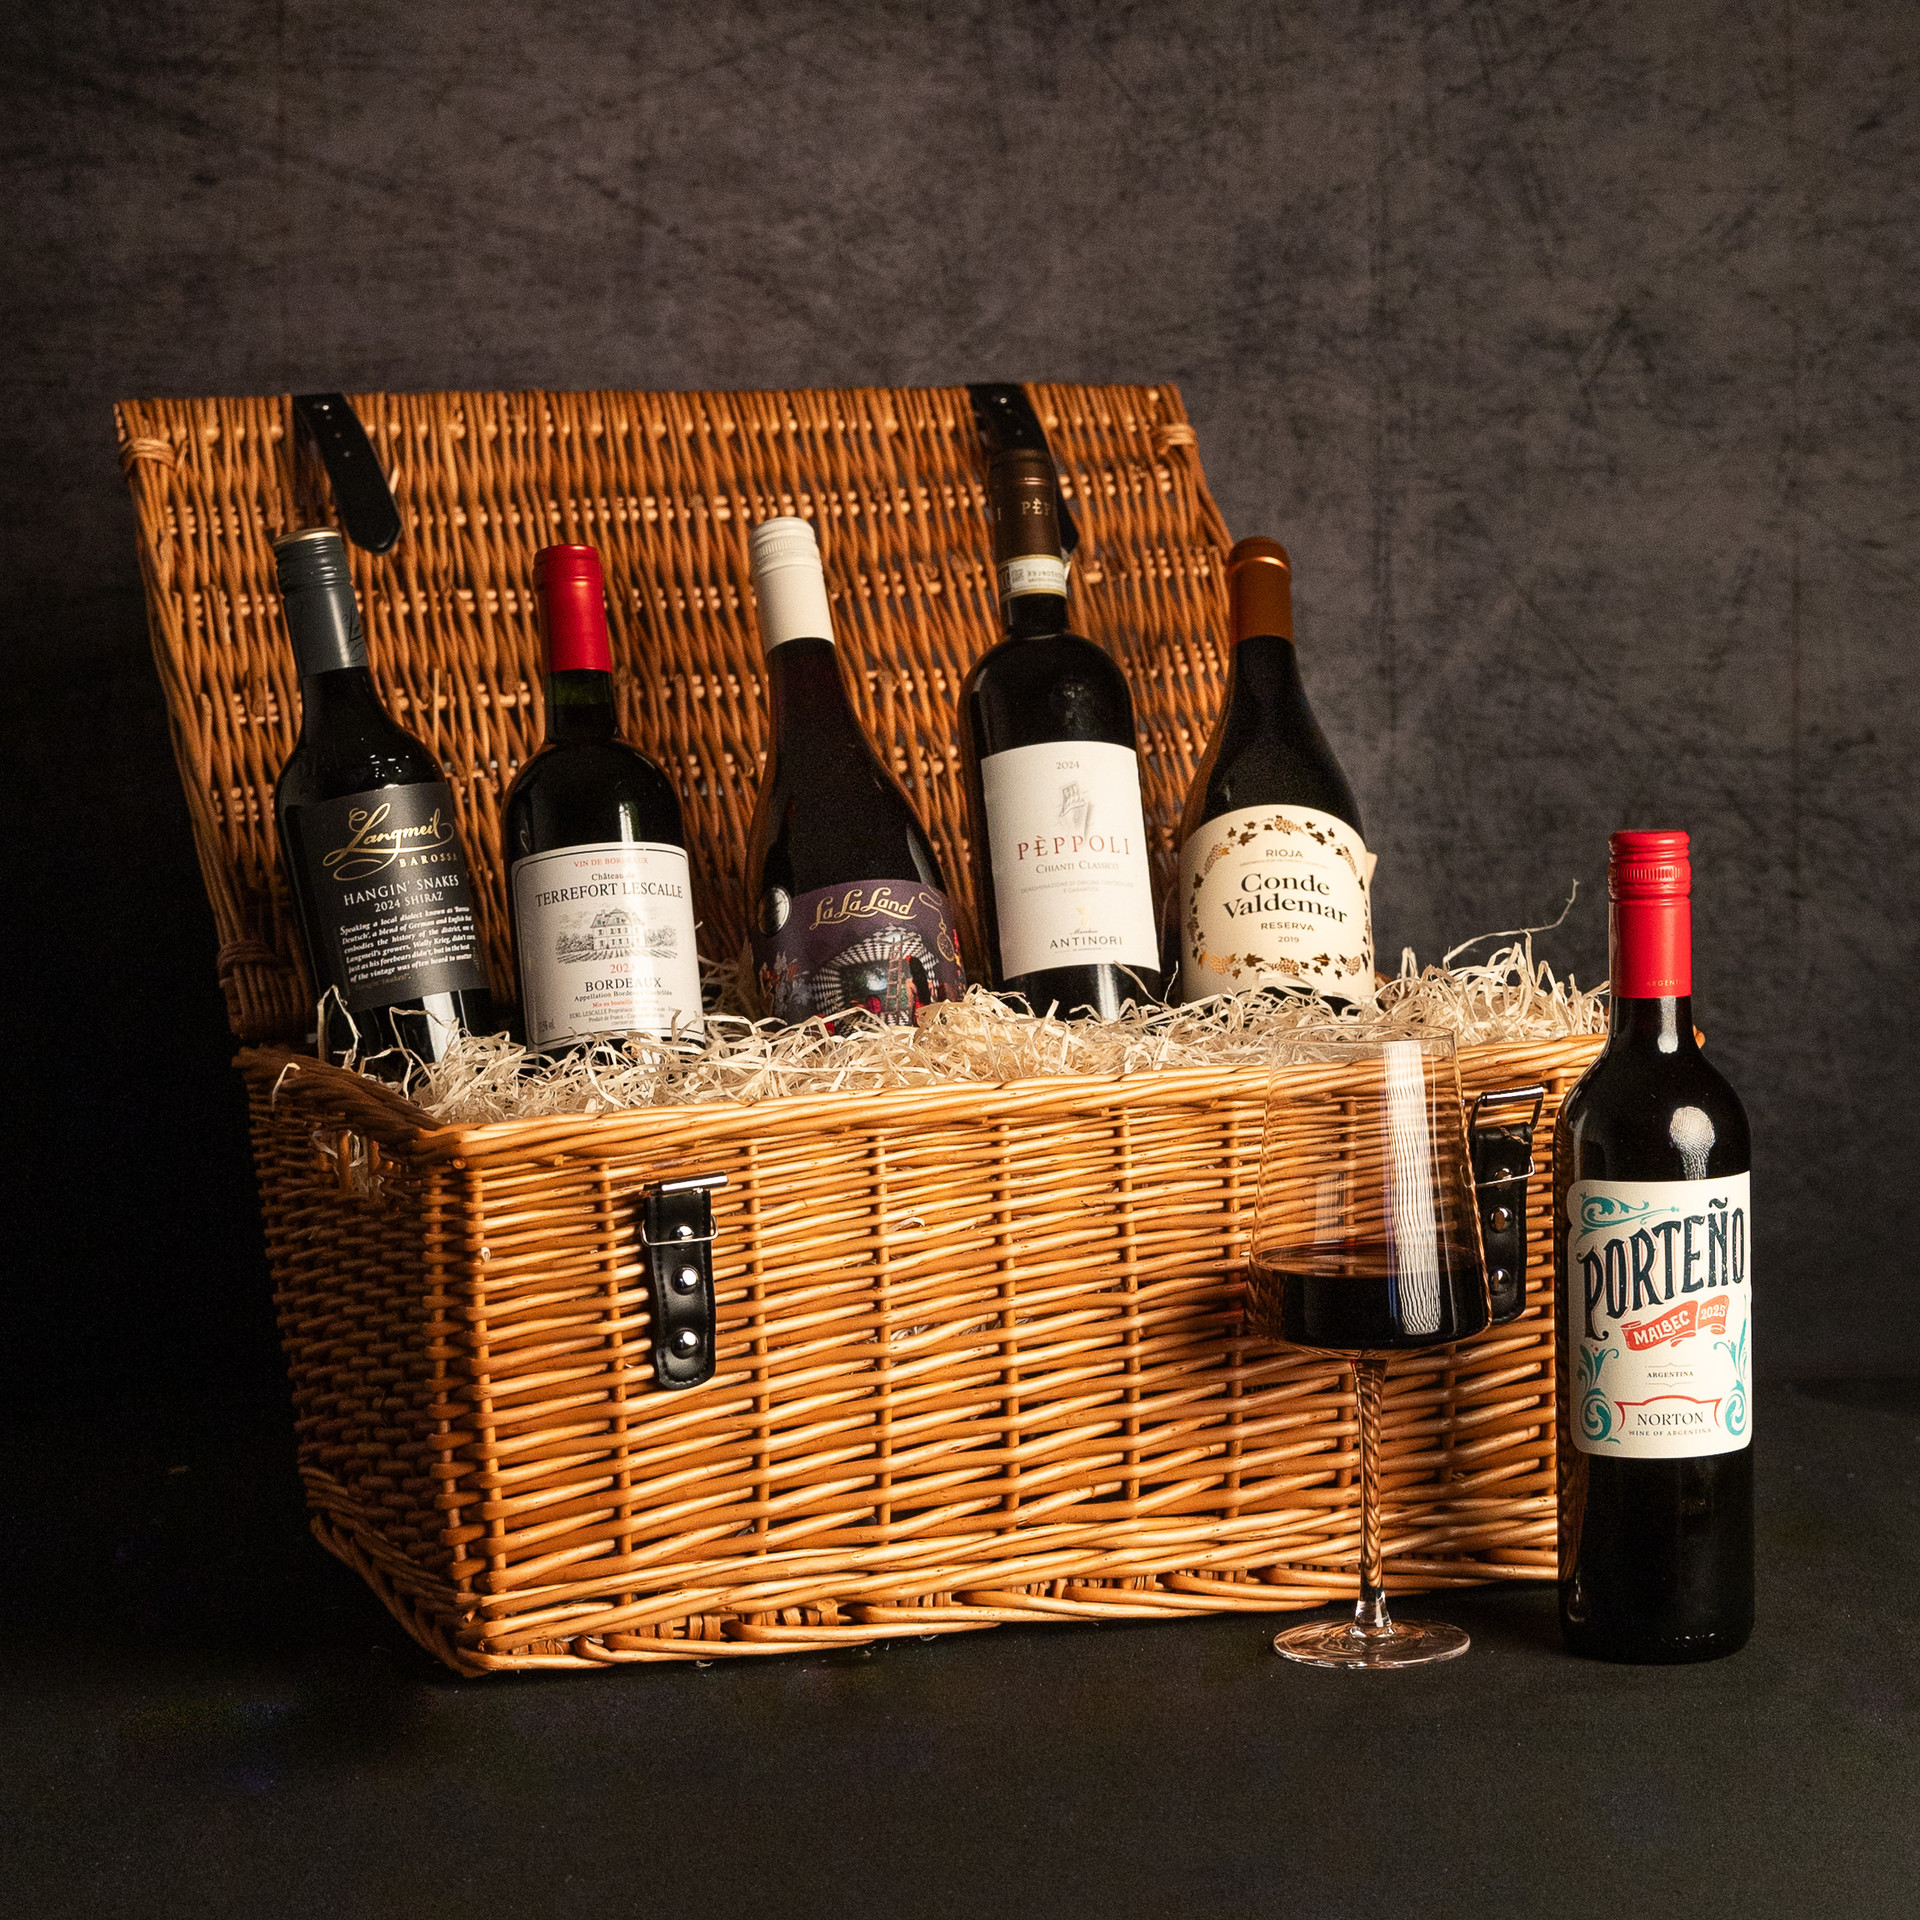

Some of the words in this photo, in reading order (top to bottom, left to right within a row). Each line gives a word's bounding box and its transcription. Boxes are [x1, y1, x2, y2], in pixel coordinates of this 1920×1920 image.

[1056, 761, 1080, 770] 2024
[322, 802, 454, 881] Langmeil
[1017, 835, 1130, 861] PÈPPOLI
[1266, 849, 1304, 859] RIOJA
[573, 860, 589, 868] VIN
[416, 875, 459, 891] SNAKES
[592, 871, 624, 881] Château
[1241, 873, 1330, 896] Conde
[374, 899, 400, 913] 2024
[405, 891, 444, 906] SHIRAZ
[535, 882, 618, 908] TERREFORT
[622, 882, 683, 899] LESCALLE
[809, 896, 842, 930] La
[834, 889, 868, 918] La
[861, 886, 917, 920] Land
[1222, 893, 1348, 923] Valdemar
[340, 923, 371, 935] Speaking
[380, 915, 398, 926] local
[400, 911, 423, 921] dialect
[379, 924, 398, 936] blend
[399, 923, 408, 932] of
[408, 920, 435, 930] German
[436, 917, 447, 925] and
[1260, 921, 1315, 932] RESERVA
[344, 942, 374, 955] embodies
[377, 938, 389, 947] the
[392, 933, 416, 943] history
[419, 930, 427, 938] of
[428, 928, 439, 936] the
[1049, 936, 1123, 949] ANTINORI
[349, 974, 358, 983] of
[358, 972, 369, 980] the
[370, 966, 395, 977] vintage
[411, 960, 430, 969] often
[585, 977, 662, 992] BORDEAUX
[574, 992, 612, 1003] Appellation
[582, 1008, 607, 1018] LESCALLE
[1576, 1196, 1745, 1342] PORTEÑO
[1632, 1310, 1690, 1345] MALBEC
[1700, 1304, 1726, 1320] 2025
[1637, 1411, 1704, 1426] NORTON
[1667, 1428, 1712, 1436] ARGENTINA
